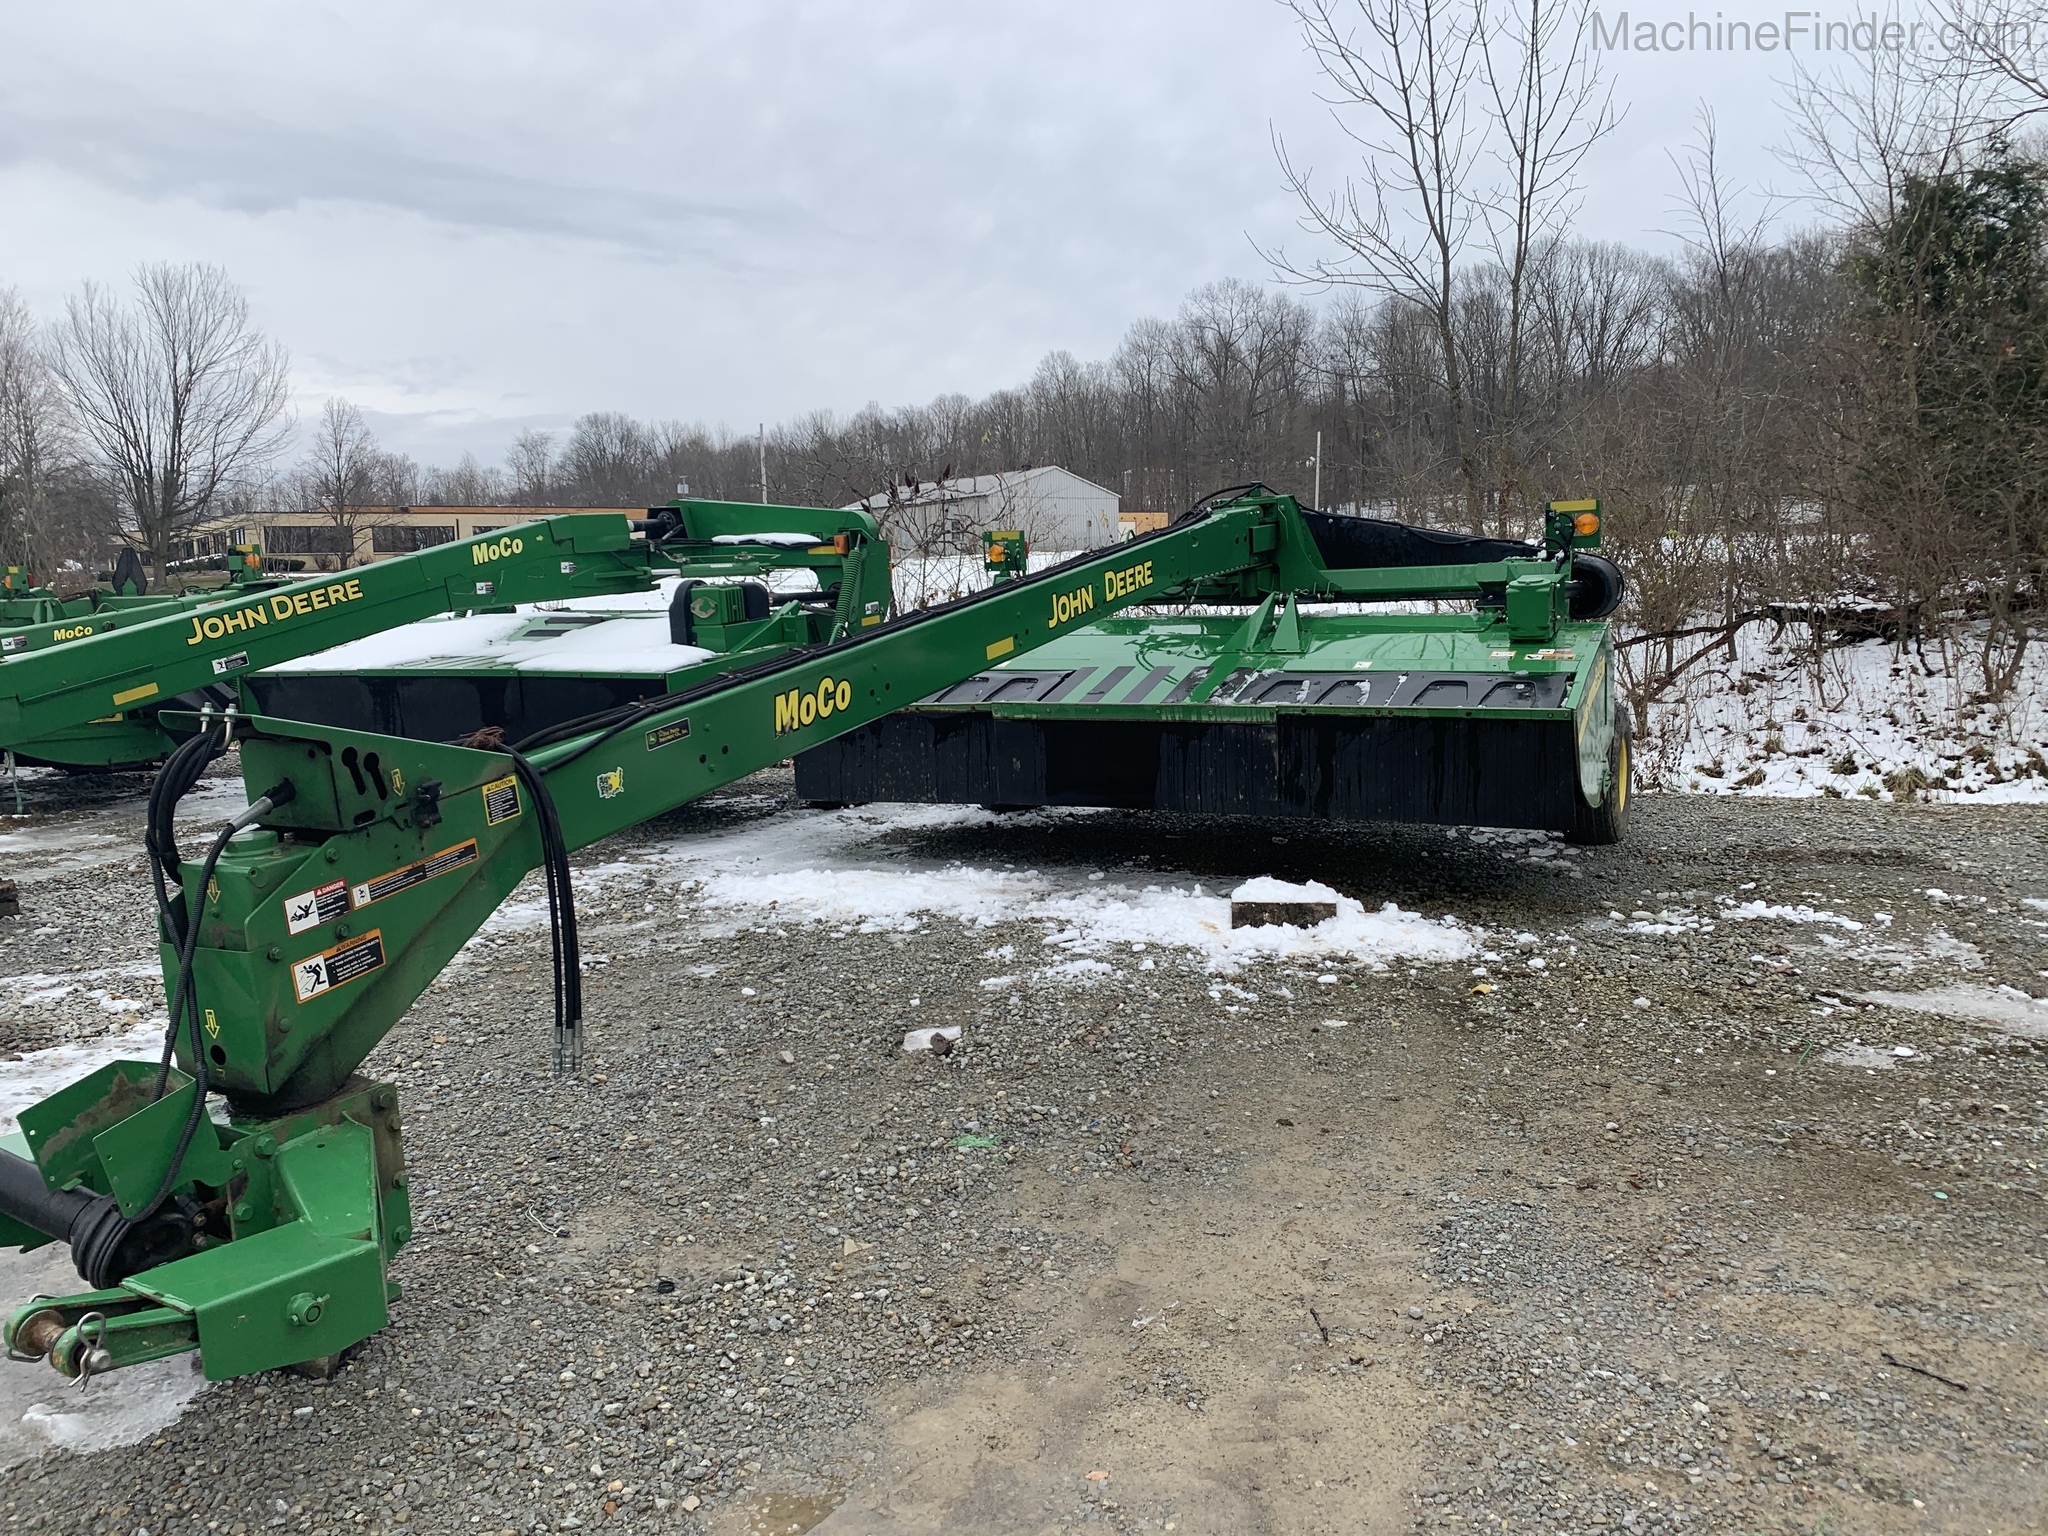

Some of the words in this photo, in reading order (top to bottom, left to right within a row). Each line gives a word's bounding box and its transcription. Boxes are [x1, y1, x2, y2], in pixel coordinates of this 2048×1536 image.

[471, 536, 523, 565] MoCo
[1048, 583, 1094, 629] JOHN
[1104, 560, 1154, 602] DEERE
[186, 604, 268, 646] JOHN
[269, 579, 364, 622] DEERE
[53, 625, 93, 641] MoCo
[775, 676, 852, 735] MoCo
[490, 779, 514, 790] CAUTION
[322, 880, 344, 895] DANGER
[340, 934, 367, 951] WARNING
